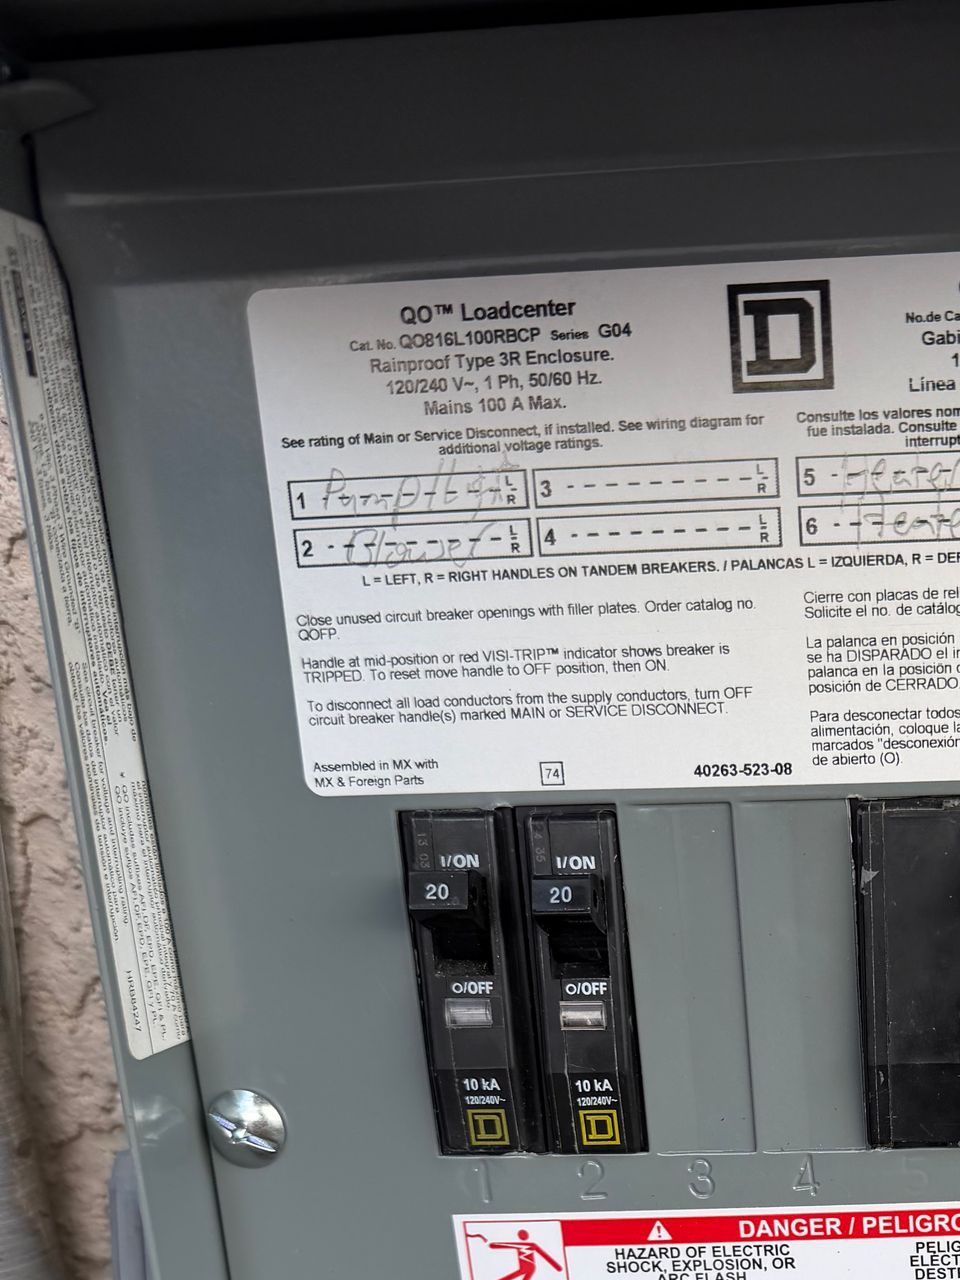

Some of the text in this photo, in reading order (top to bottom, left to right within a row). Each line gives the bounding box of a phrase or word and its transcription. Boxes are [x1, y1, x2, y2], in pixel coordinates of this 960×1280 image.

[400, 299, 576, 324] QO™ Loadcenter
[905, 311, 941, 322] No.de
[376, 339, 395, 349] No.
[399, 327, 540, 348] QO816L100RBCP
[598, 322, 632, 338] G04
[370, 348, 614, 374] Rainproof Type 3R Enclosure.
[386, 369, 602, 394] 120/240 V~, 1 Ph, 50/60 Hz.
[423, 395, 566, 415] Mains 100 A Max.
[804, 468, 815, 486] 5
[541, 479, 552, 498] 3
[297, 492, 306, 509] 1
[805, 517, 818, 535] 6
[544, 527, 556, 545] 4
[302, 540, 313, 557] 2
[296, 597, 756, 626] Close unused circuit breaker openings with filler plates. Order catalog no.
[297, 627, 339, 641] QOFP.
[313, 758, 438, 772] Assembled in MX with
[545, 768, 559, 779] 74
[693, 762, 792, 777] 40263-523-08
[314, 774, 424, 788] MX & Foreign Parts
[425, 884, 449, 899] 20
[550, 887, 572, 903] 20
[463, 1079, 500, 1091] 10 kA
[576, 1080, 613, 1092] 10 kA
[577, 1161, 607, 1200] 2
[688, 1159, 716, 1199] 3
[793, 1154, 820, 1197] 4
[739, 1217, 842, 1238] DANGER
[614, 1244, 789, 1259] HAZARD OF ELECTRIC
[606, 1257, 795, 1274] SHOCK, EXPLOSION, OR
